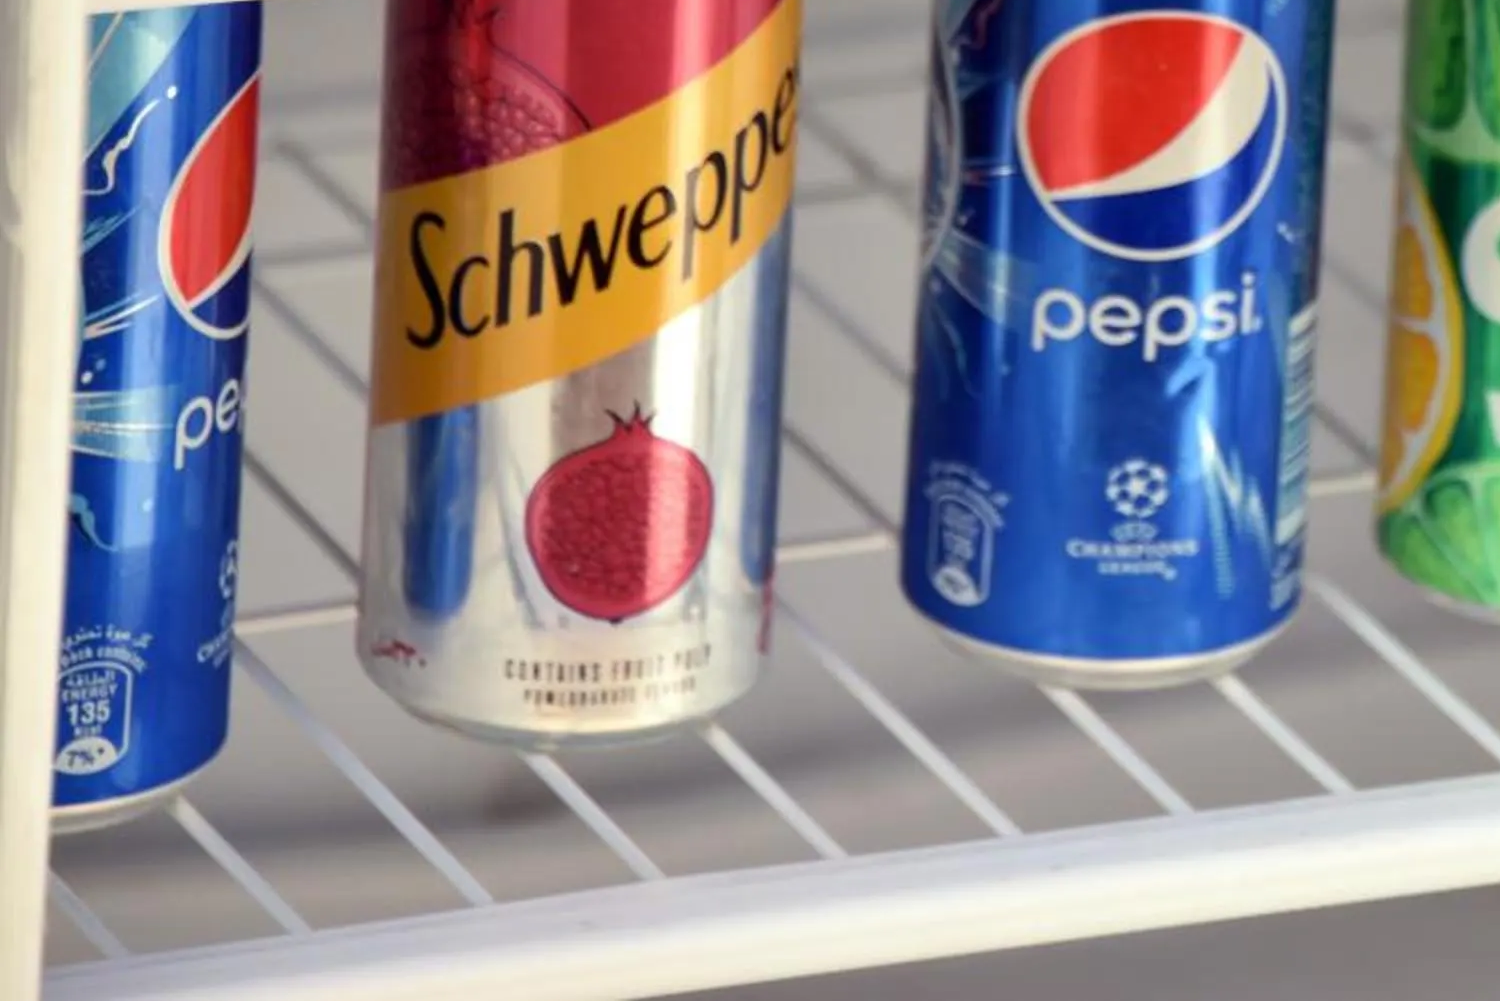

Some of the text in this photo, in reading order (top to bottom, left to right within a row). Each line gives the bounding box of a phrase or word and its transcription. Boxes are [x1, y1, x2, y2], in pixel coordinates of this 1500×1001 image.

[406, 66, 799, 349] Schweppe
[1032, 272, 1263, 360] pepsi
[174, 378, 240, 471] pe
[1066, 538, 1198, 559] CHAMPIONS
[67, 701, 111, 726] 135
